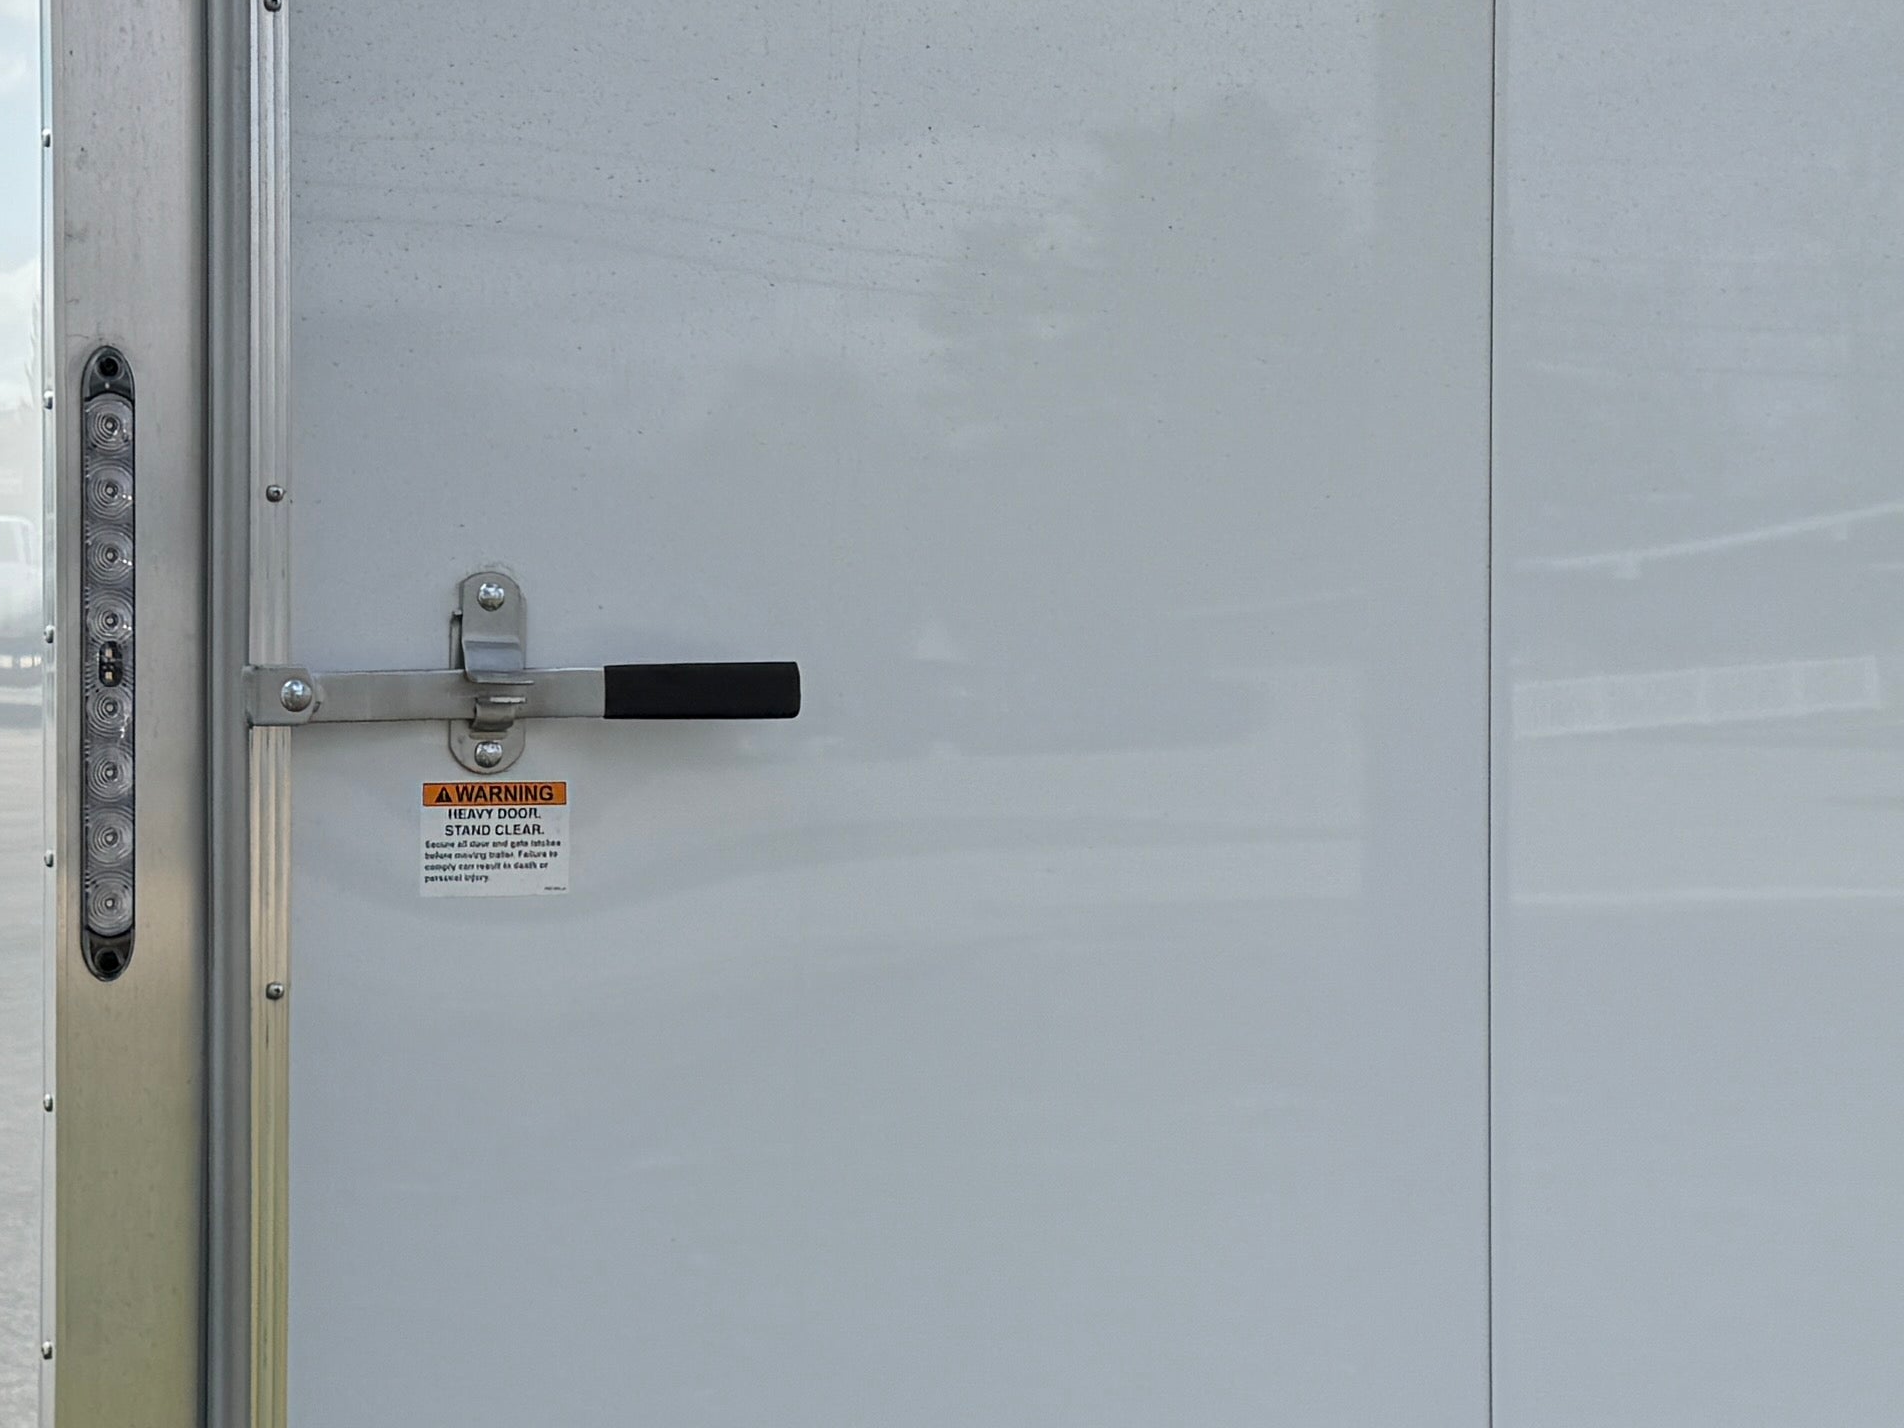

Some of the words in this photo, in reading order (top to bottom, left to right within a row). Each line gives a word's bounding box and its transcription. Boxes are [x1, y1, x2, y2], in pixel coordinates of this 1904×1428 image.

[455, 784, 554, 803] WARNING
[448, 807, 494, 820] HEAVY
[497, 807, 542, 819] DOOR.
[444, 824, 491, 837] STAND
[495, 823, 545, 836] CLEAR.
